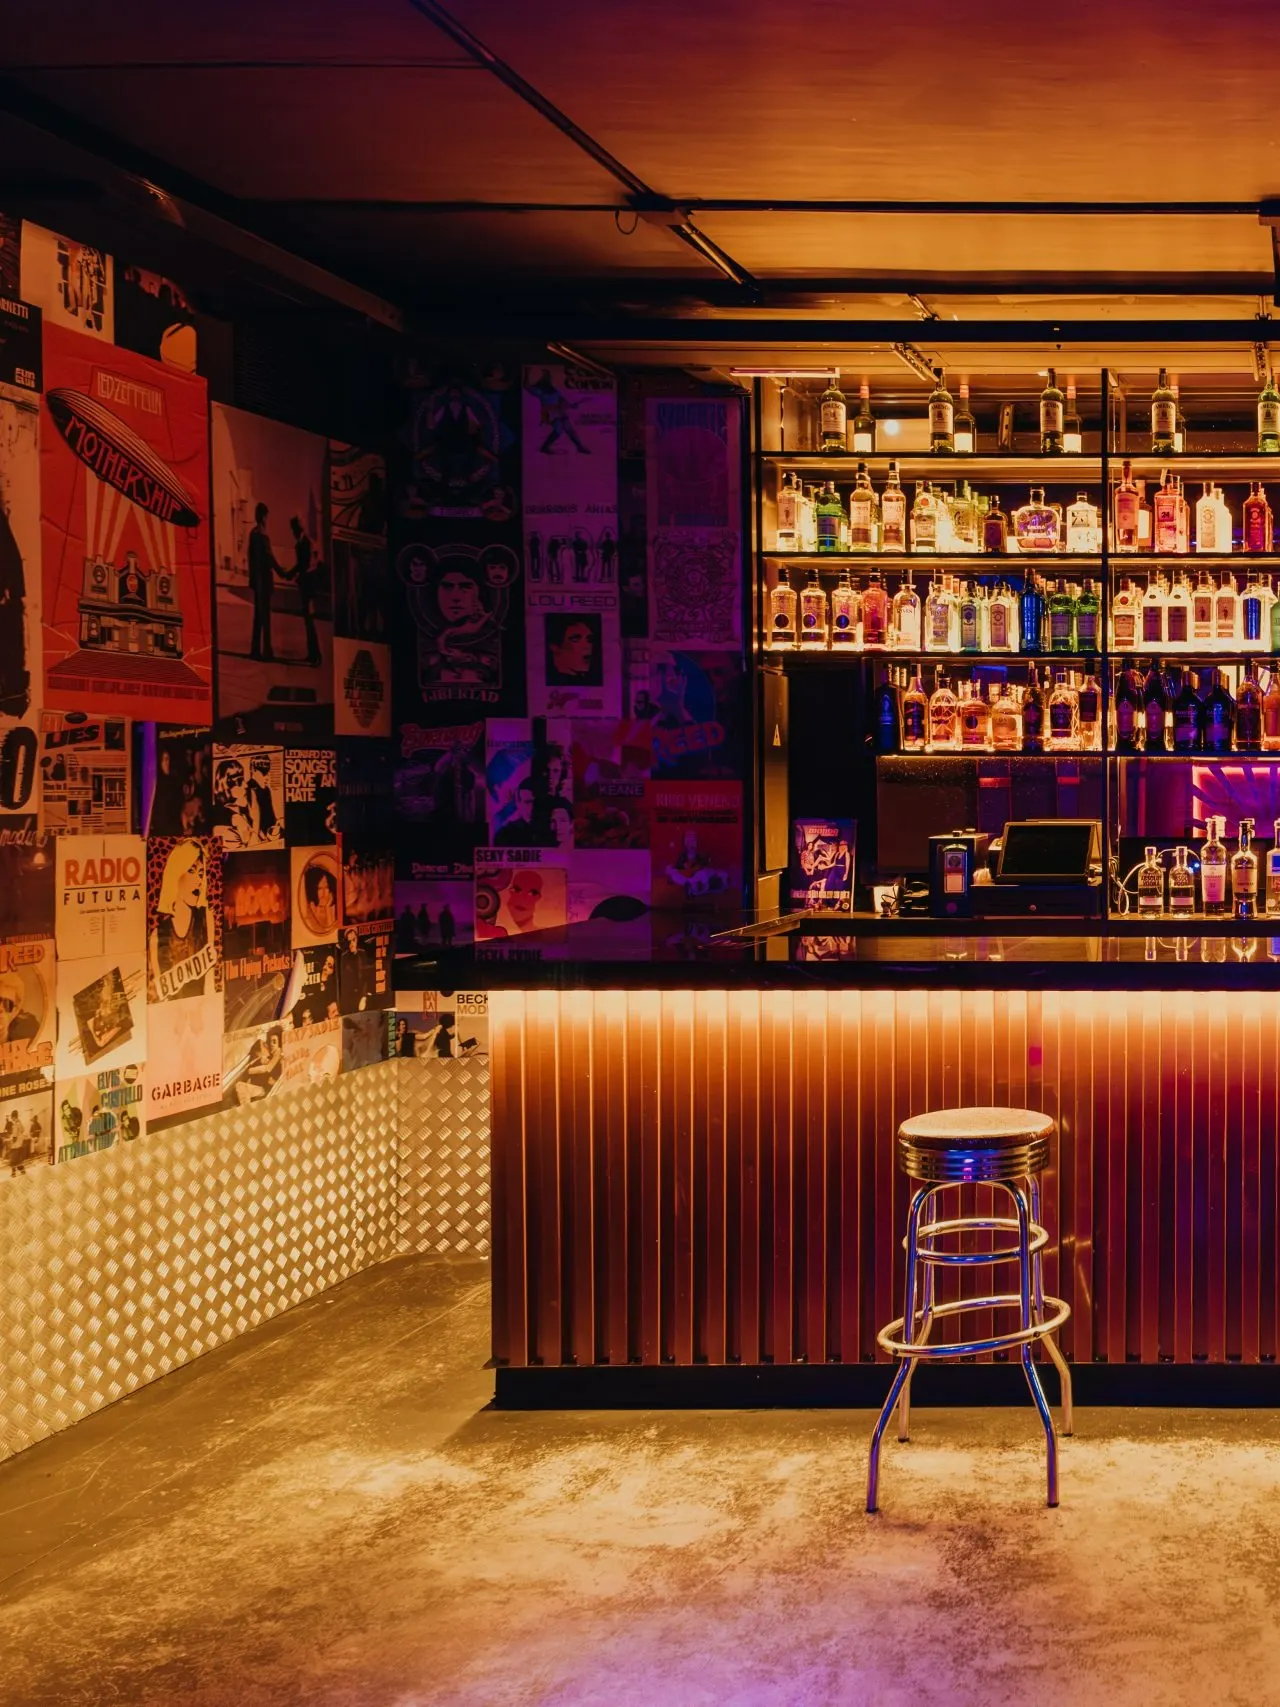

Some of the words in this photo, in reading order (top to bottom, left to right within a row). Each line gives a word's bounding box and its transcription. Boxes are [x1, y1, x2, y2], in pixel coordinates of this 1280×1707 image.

[64, 413, 181, 520] MOTHERSHIP
[528, 595, 565, 607] LOU
[571, 596, 616, 607] REED
[285, 759, 328, 773] SONGS
[285, 773, 316, 788] LOVE
[285, 788, 316, 803] HATE
[599, 784, 643, 796] KEANE
[476, 849, 503, 862] SEXY
[506, 849, 543, 862] SADIE
[65, 857, 141, 886] RADIO
[63, 889, 141, 905] FUTURA
[160, 946, 214, 996] BLONDIE
[457, 1005, 488, 1014] MOD
[151, 1073, 221, 1101] GARBAGE
